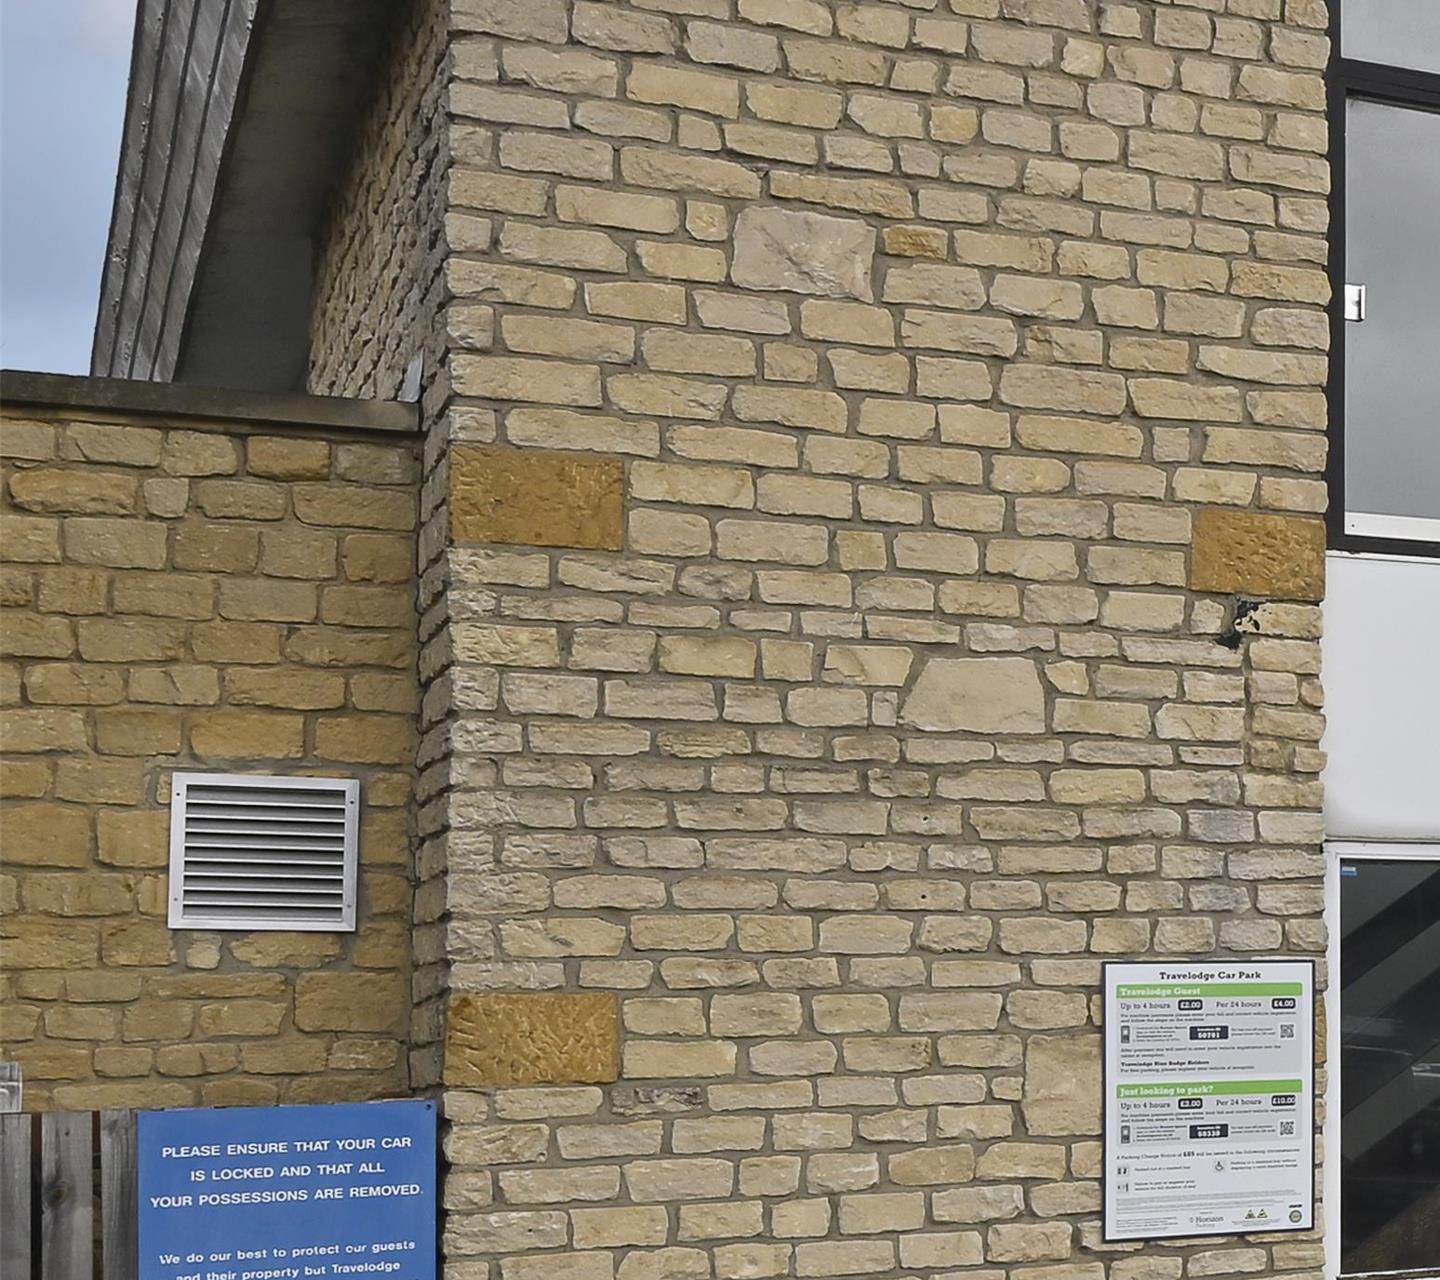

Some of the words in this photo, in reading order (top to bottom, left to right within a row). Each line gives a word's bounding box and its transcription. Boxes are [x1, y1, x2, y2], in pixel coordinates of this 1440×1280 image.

[1159, 971, 1215, 981] Travelodge
[1218, 971, 1236, 979] Car
[1239, 971, 1262, 979] Park
[1120, 987, 1171, 997] Travelodge
[1174, 987, 1200, 995] Guest
[1120, 1088, 1138, 1097] Just
[1140, 1087, 1175, 1096] looking
[1187, 1085, 1214, 1095] park?
[162, 1145, 221, 1158] PLEASE
[227, 1142, 288, 1155] ENSURE
[294, 1140, 330, 1152] THAT
[336, 1139, 376, 1151] YOUR
[381, 1137, 412, 1149] CAR
[191, 1170, 205, 1181] IS
[212, 1167, 274, 1181] LOCKED
[280, 1165, 311, 1177] AND
[317, 1163, 353, 1175] THAT
[358, 1162, 385, 1174] ALL
[150, 1196, 193, 1209] YOUR
[199, 1190, 308, 1206] POSSESSIONS
[314, 1188, 343, 1200] ARE
[350, 1184, 424, 1198] REMOVED.
[159, 1254, 180, 1266] We
[186, 1253, 204, 1264] do
[209, 1252, 231, 1262] our
[237, 1249, 267, 1261] best
[273, 1248, 287, 1258] to
[292, 1244, 340, 1258] protect
[345, 1245, 368, 1254] our
[372, 1240, 415, 1254] guests
[304, 1265, 326, 1276] but
[331, 1261, 401, 1275] Travelodge
